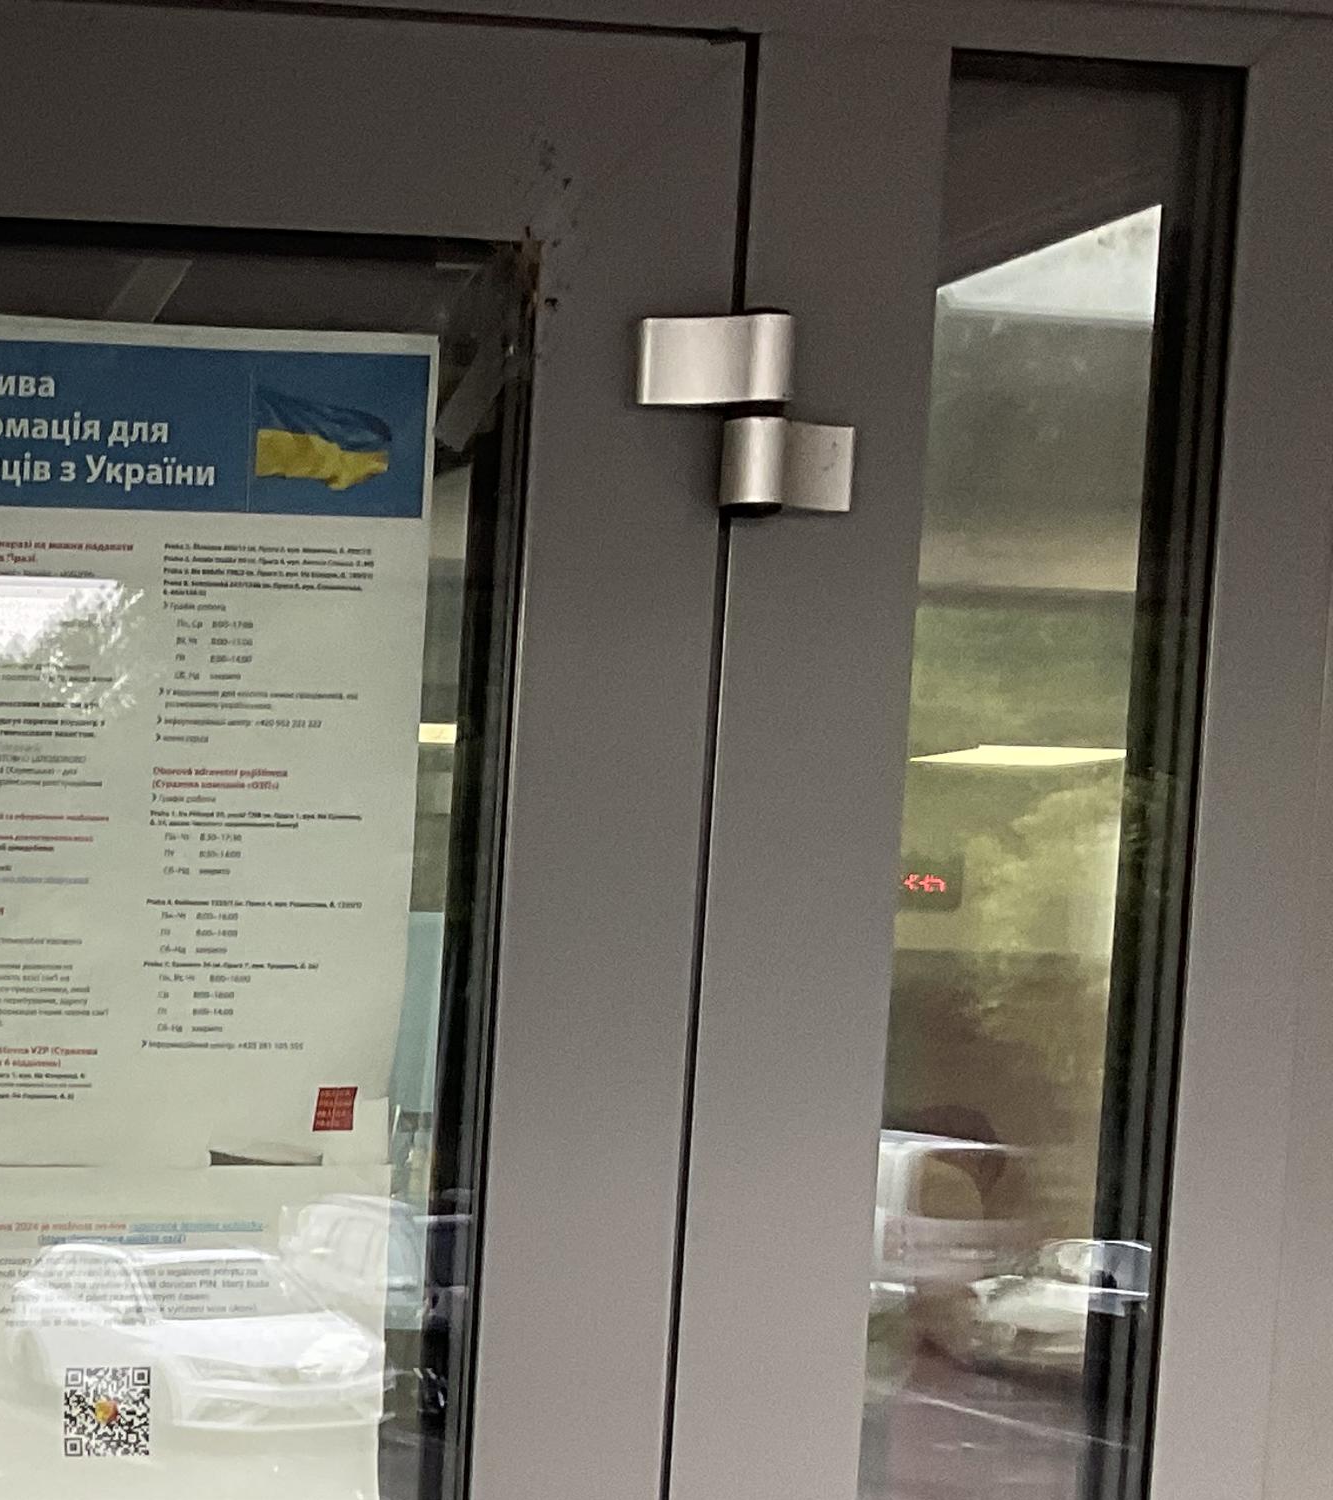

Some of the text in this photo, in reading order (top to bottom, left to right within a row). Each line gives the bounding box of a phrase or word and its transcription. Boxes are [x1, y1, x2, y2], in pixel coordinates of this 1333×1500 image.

[108, 418, 170, 447] для
[59, 459, 77, 482] з
[85, 454, 215, 490] України
